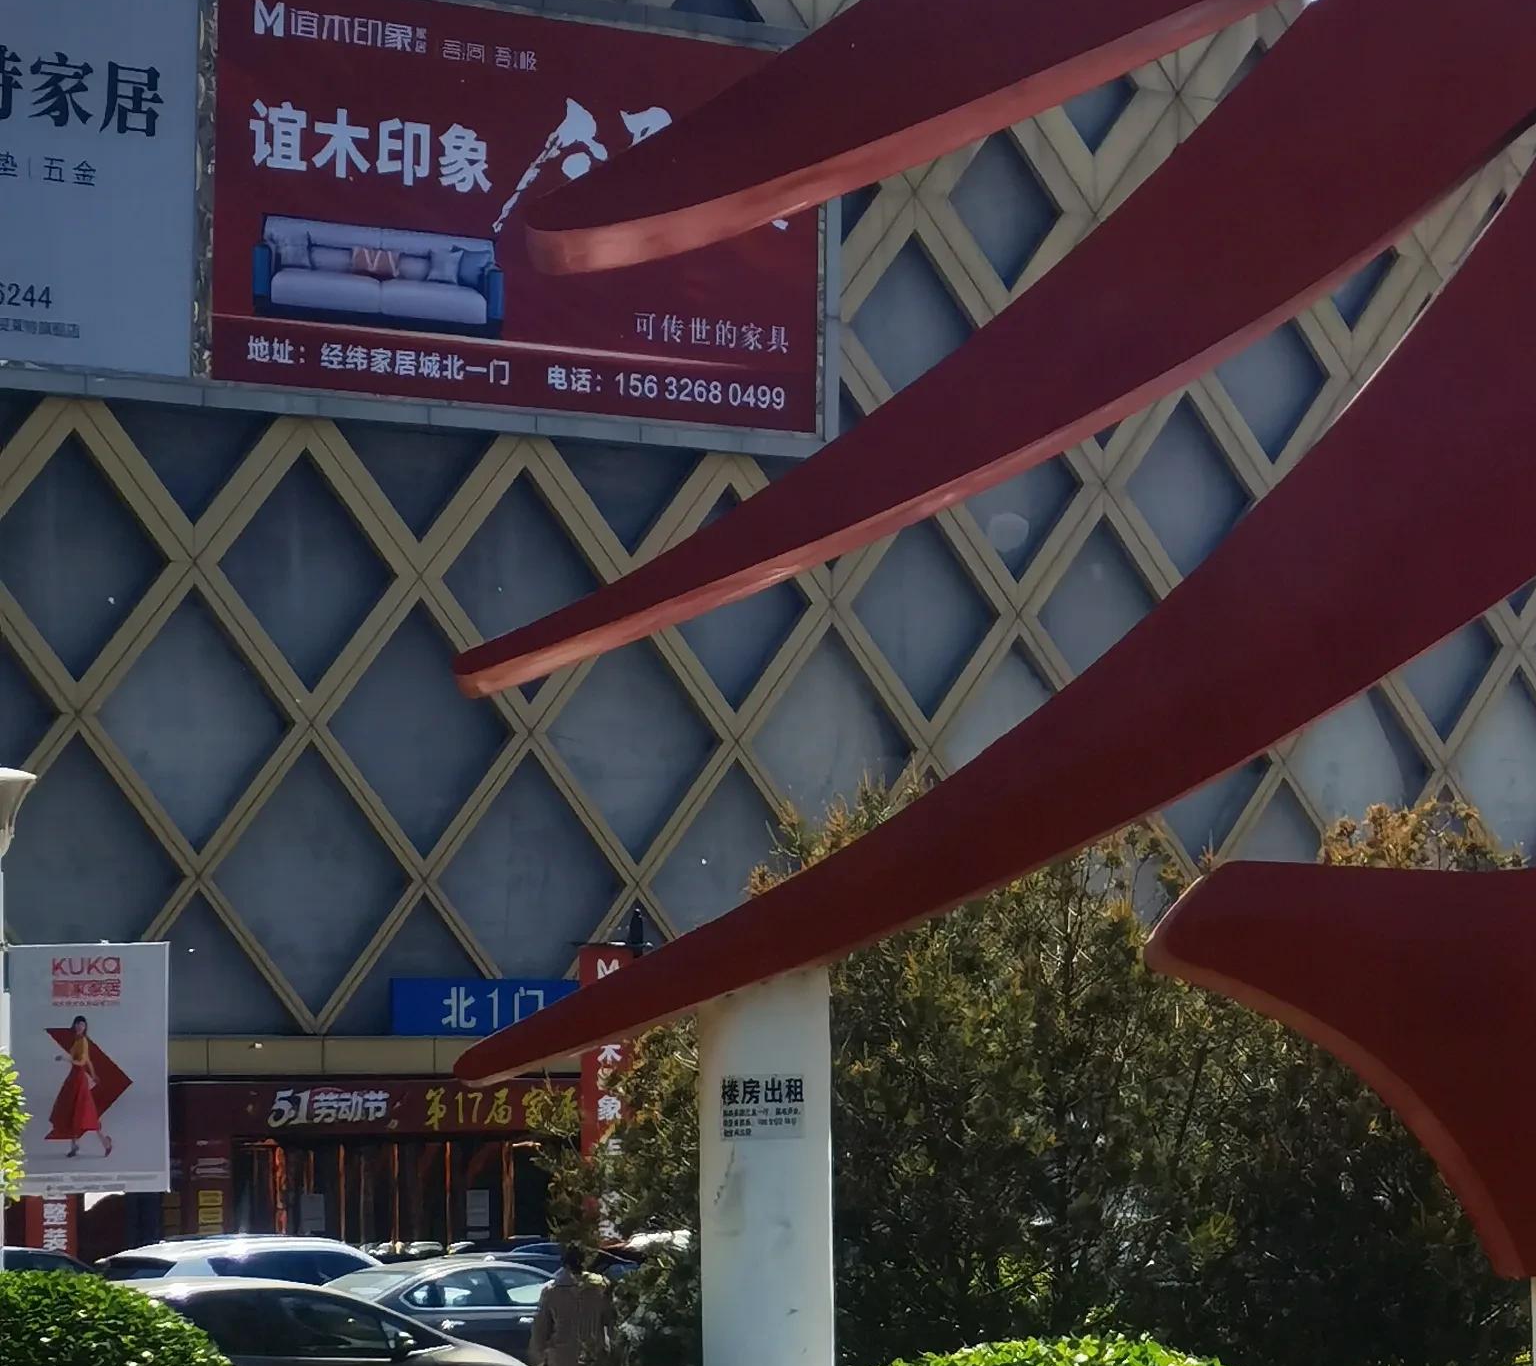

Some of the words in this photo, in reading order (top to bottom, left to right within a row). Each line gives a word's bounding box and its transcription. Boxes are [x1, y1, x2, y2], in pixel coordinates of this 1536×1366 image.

[249, 98, 492, 193] 谊木印象
[633, 311, 790, 354] 可传世的家具
[441, 986, 545, 1029] 北1门
[720, 1076, 804, 1105] 楼房出租
